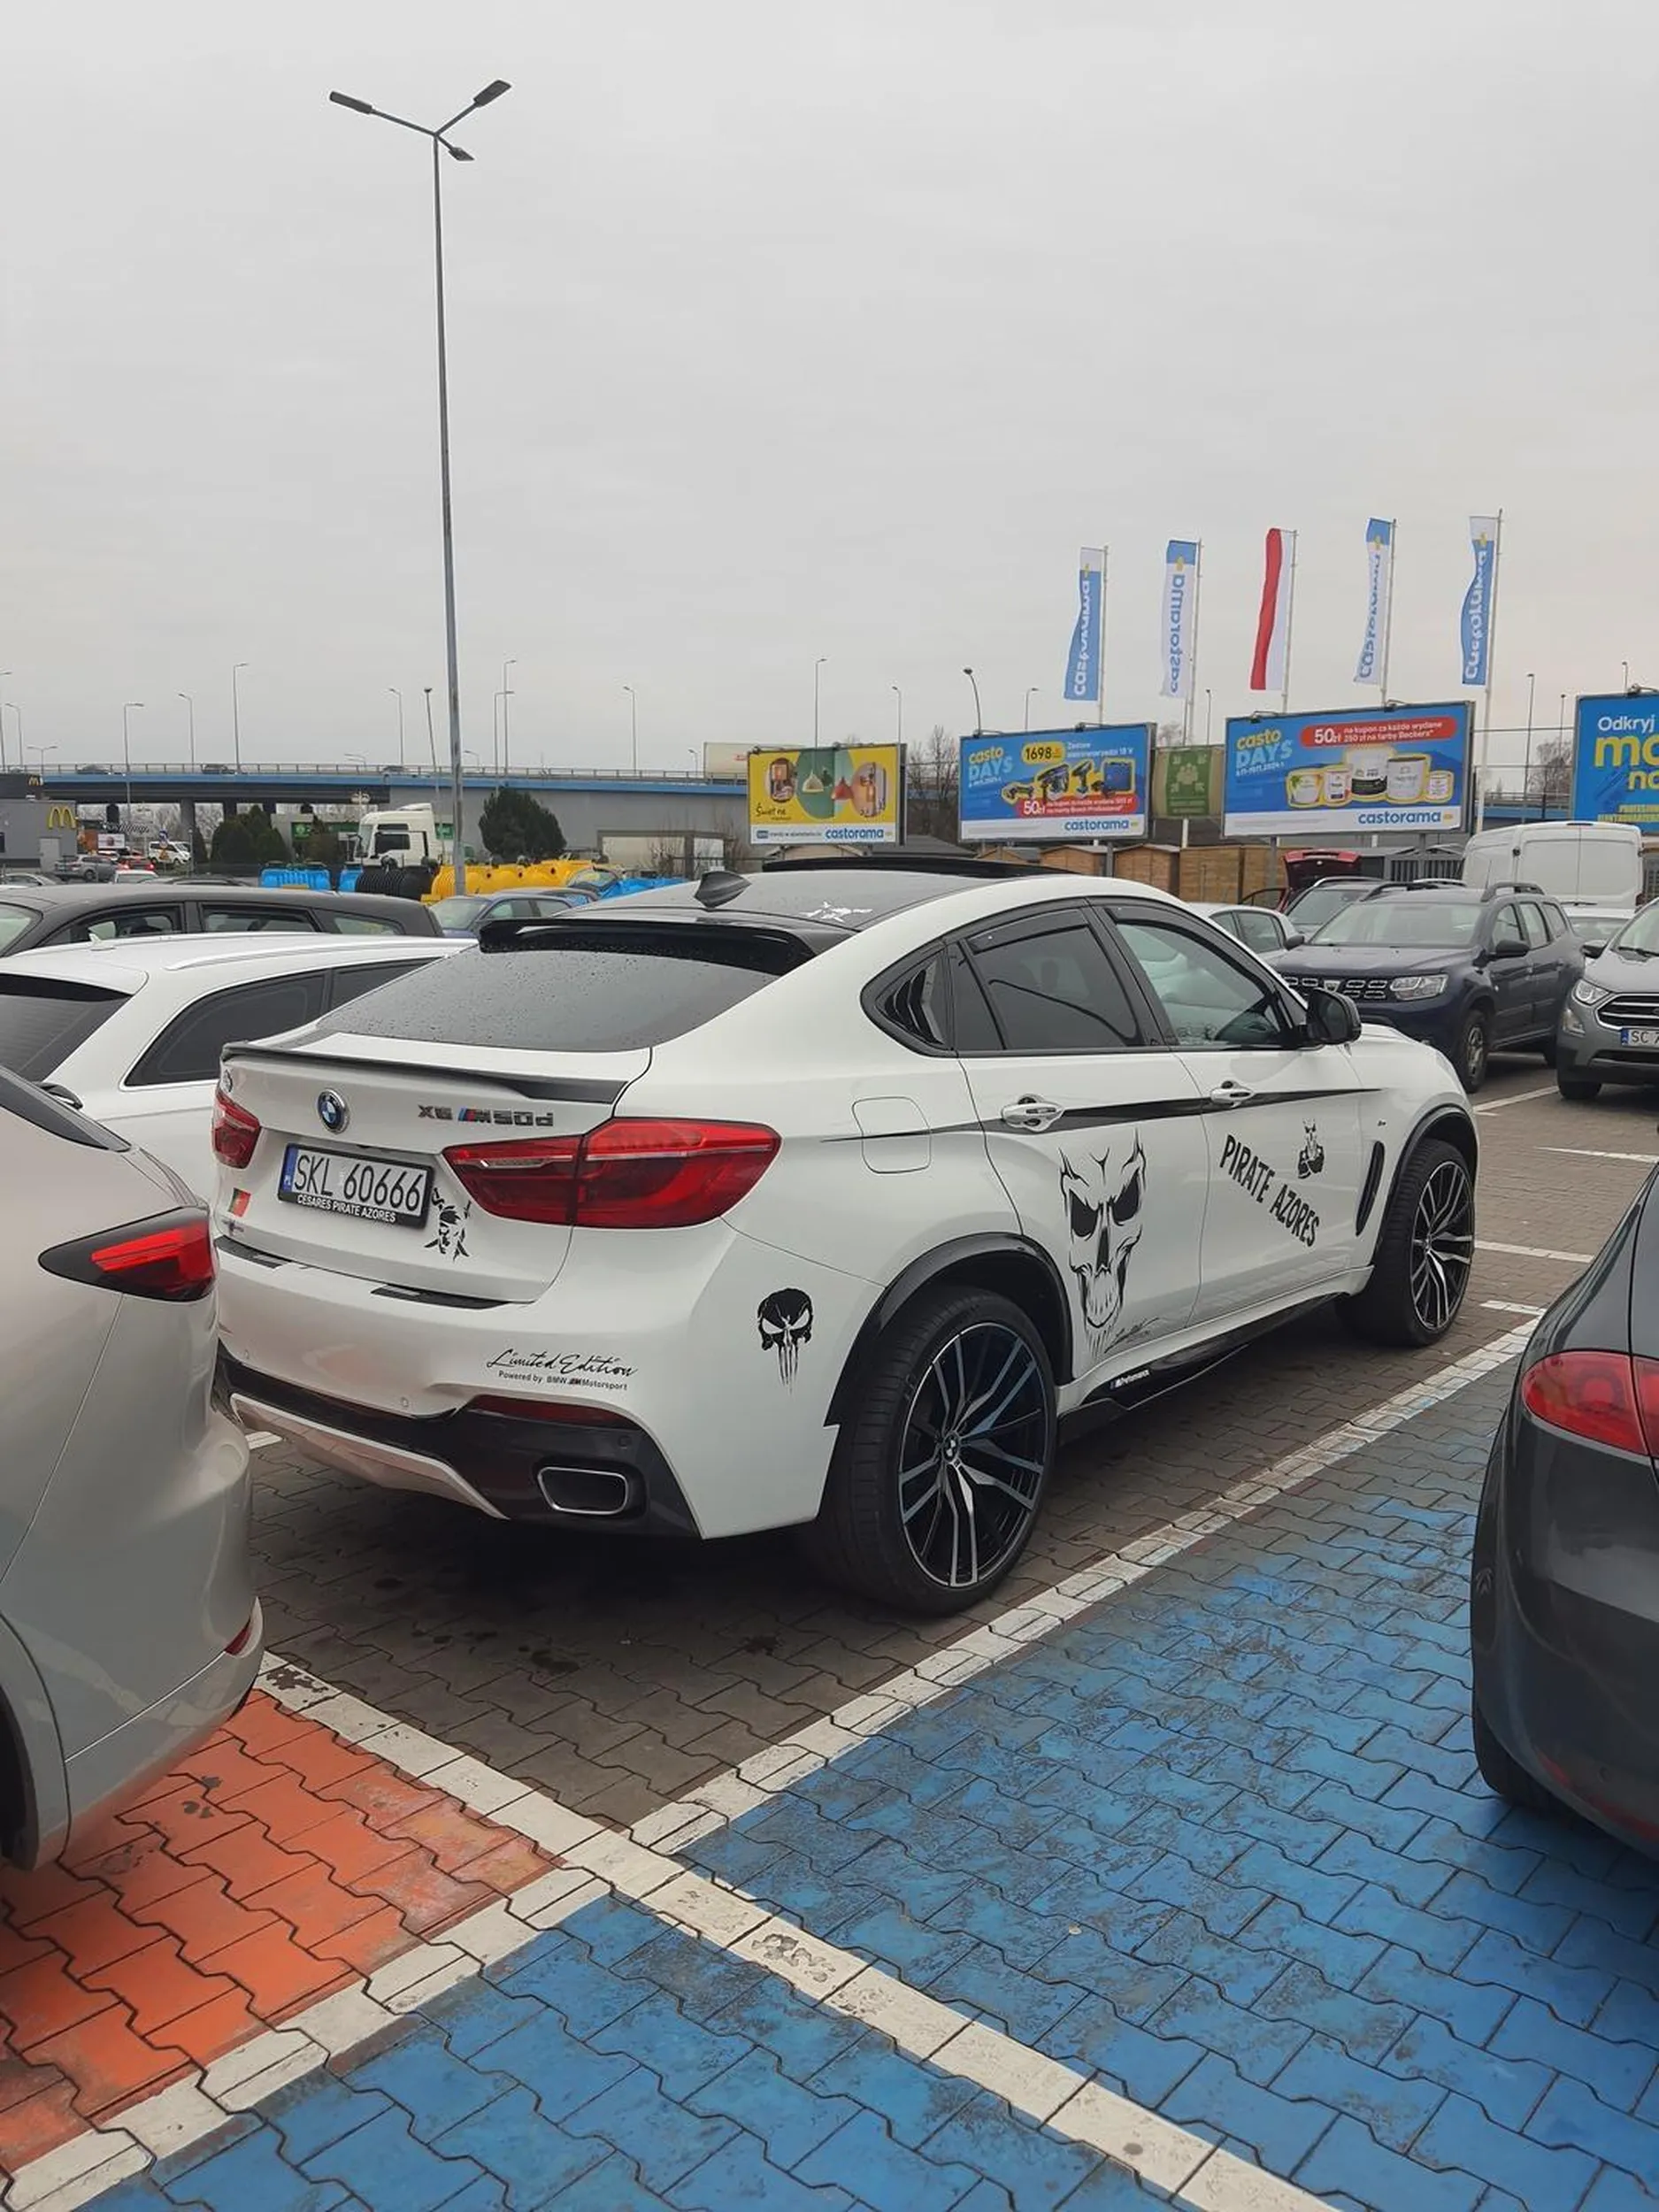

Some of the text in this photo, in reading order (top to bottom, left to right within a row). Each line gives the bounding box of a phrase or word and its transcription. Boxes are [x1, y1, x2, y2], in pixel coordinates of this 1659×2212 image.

[1598, 714, 1655, 733] Odkryj
[1237, 728, 1281, 750] casto
[969, 746, 1004, 764] casto
[1025, 747, 1052, 760] 1698
[1236, 740, 1293, 768] DAYS
[969, 756, 1013, 781] DAYS
[1064, 819, 1129, 831] castorama
[1358, 811, 1441, 824] castorama
[825, 827, 884, 840] castorama
[1632, 1031, 1649, 1043] SC
[418, 1105, 453, 1120] X6
[294, 1155, 424, 1212] SKL 60666
[1219, 1134, 1320, 1247] PIRATE AZORES
[296, 1194, 396, 1224] CESARES PIRATE AZORES
[487, 1348, 639, 1377] Limited Edition
[498, 1371, 532, 1382] Powered
[533, 1375, 544, 1384] by
[546, 1375, 567, 1385] BMW
